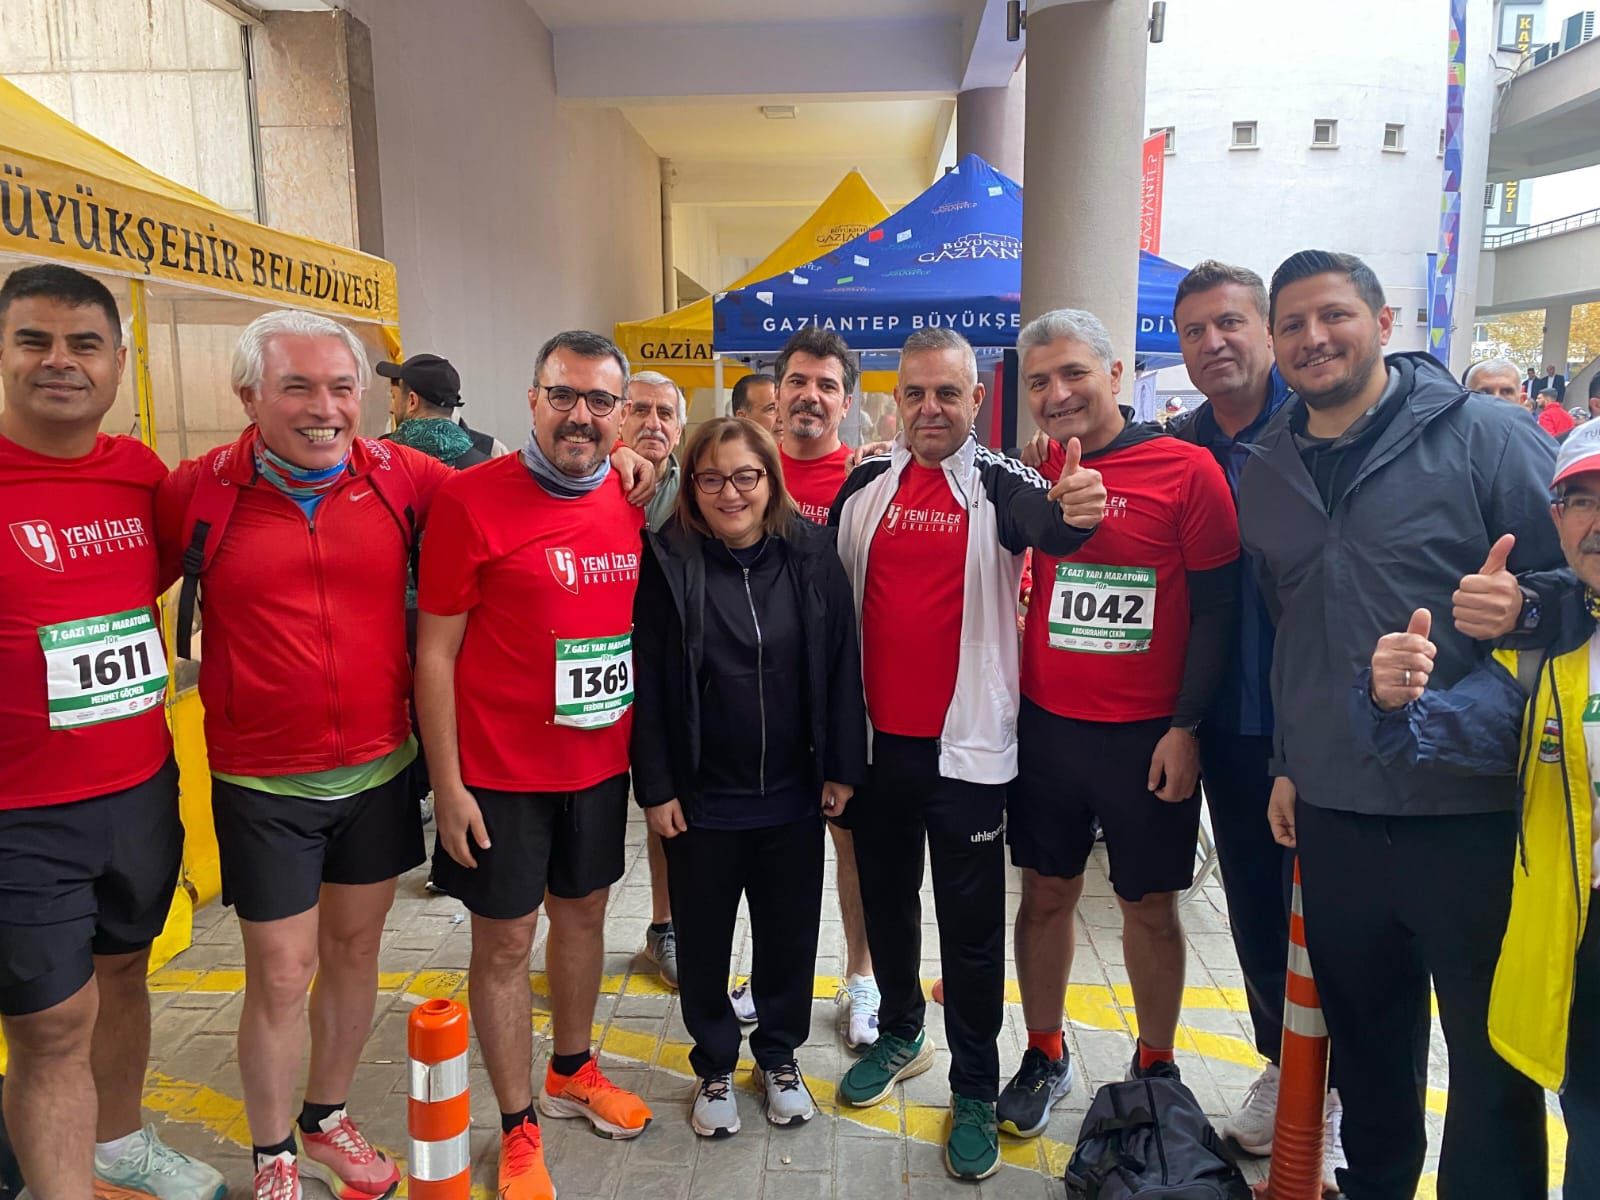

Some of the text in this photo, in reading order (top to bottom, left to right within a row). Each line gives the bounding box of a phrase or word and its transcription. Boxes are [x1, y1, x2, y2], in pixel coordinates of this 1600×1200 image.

[249, 247, 382, 311] BELEDİYESİ
[763, 314, 900, 332] GAZİANTEP
[913, 312, 1021, 330] BÜYÜKŞE
[903, 508, 961, 524] YENİ İZLER
[60, 517, 144, 545] YENİ İZLER
[69, 535, 149, 559] OKULLARI
[580, 552, 609, 572] YENİ
[1061, 590, 1145, 624] 1042
[73, 641, 151, 690] 1611
[569, 661, 627, 698] 1369
